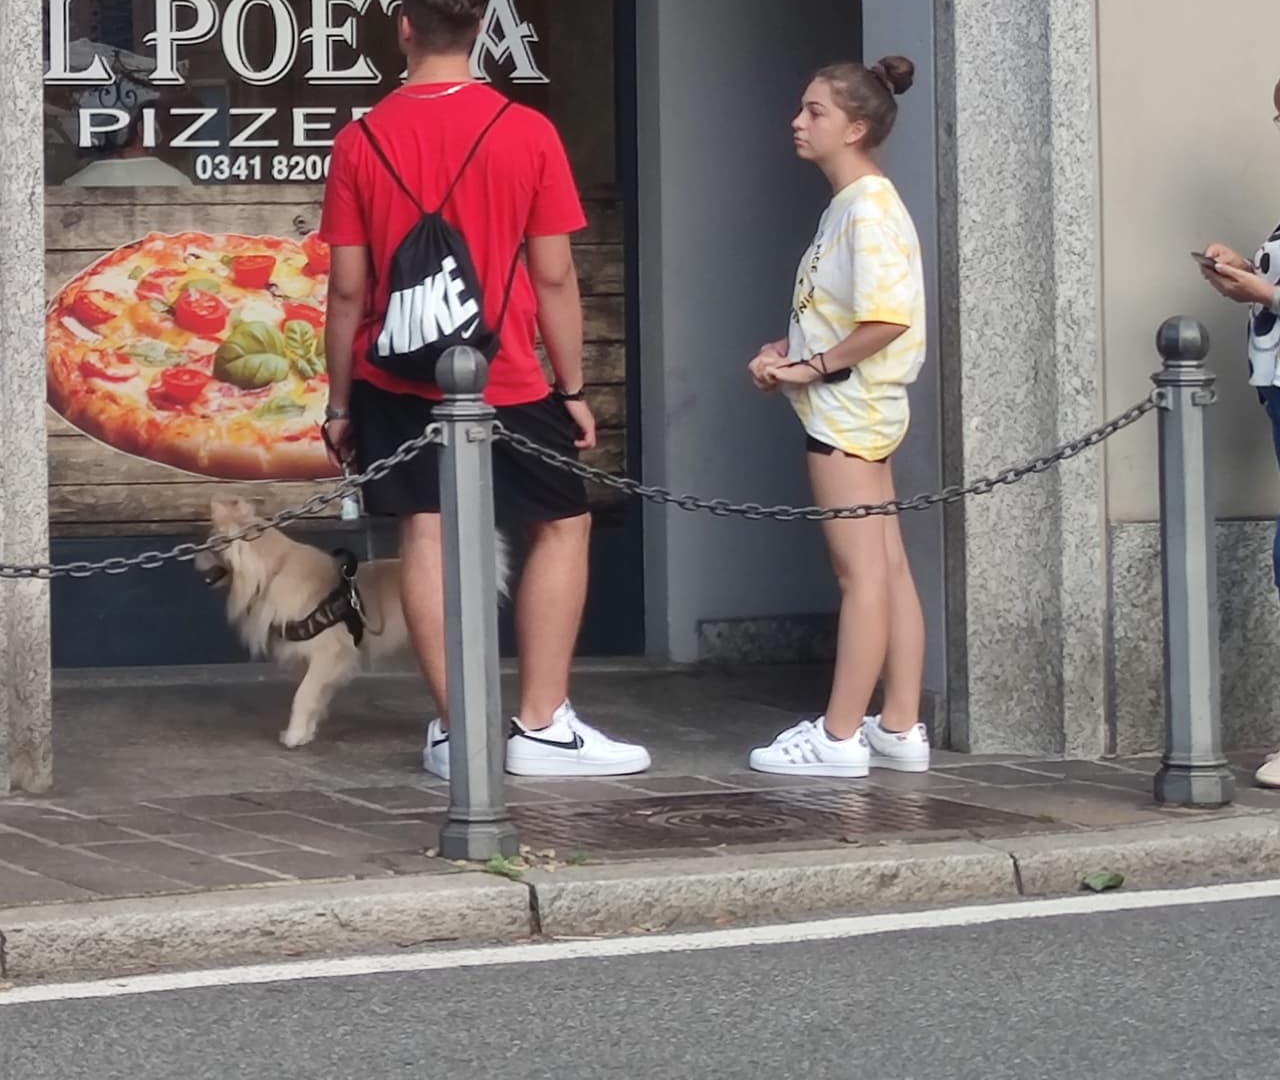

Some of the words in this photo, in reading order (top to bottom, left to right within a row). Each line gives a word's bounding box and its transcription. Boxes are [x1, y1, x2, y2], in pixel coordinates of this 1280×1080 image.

[78, 107, 374, 148] PIZZE
[195, 155, 262, 181] 0341
[377, 255, 480, 357] NIKE
